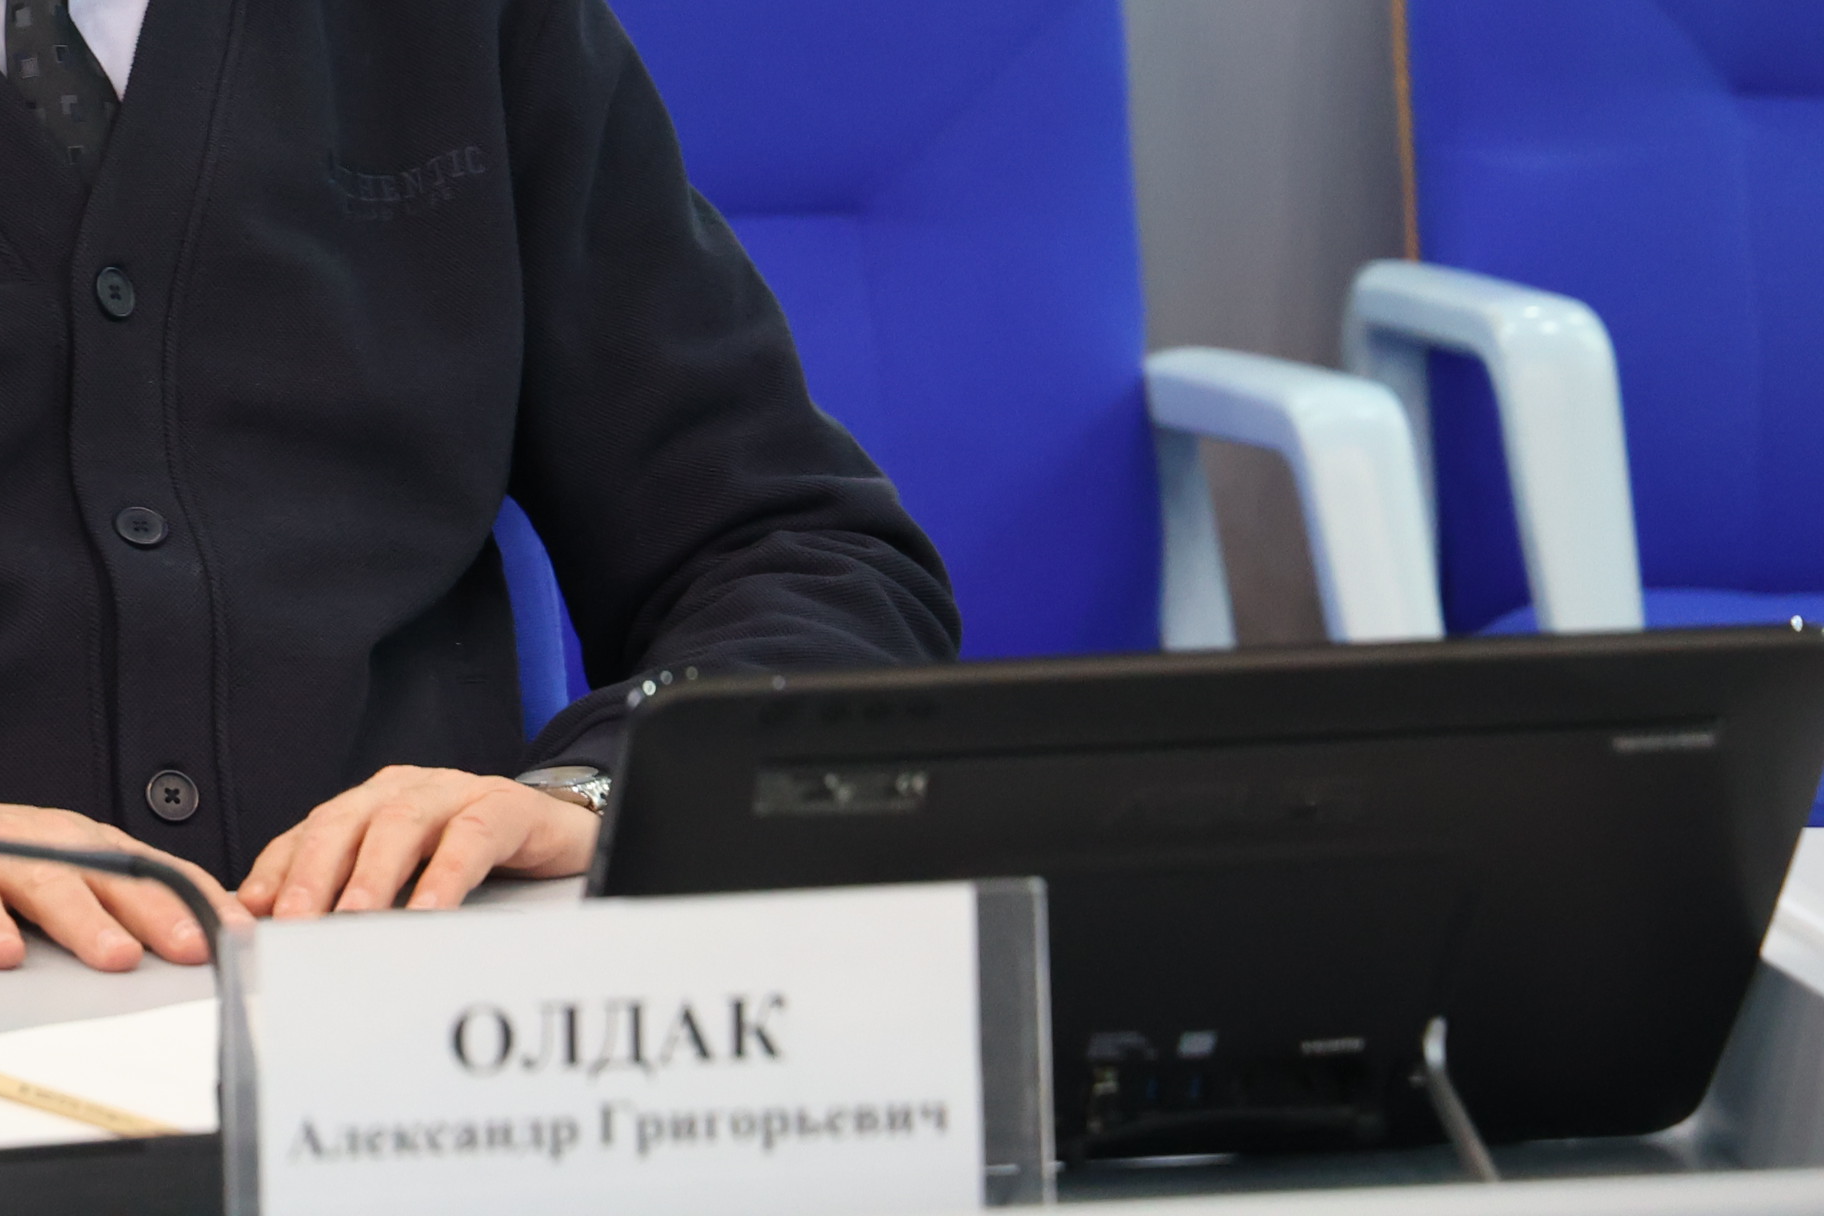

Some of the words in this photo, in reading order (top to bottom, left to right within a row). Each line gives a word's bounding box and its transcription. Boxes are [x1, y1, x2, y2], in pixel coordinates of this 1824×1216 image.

[448, 993, 787, 1081] ОЛДАК
[289, 1114, 583, 1164] Александр
[596, 1098, 950, 1158] Григорьевич
